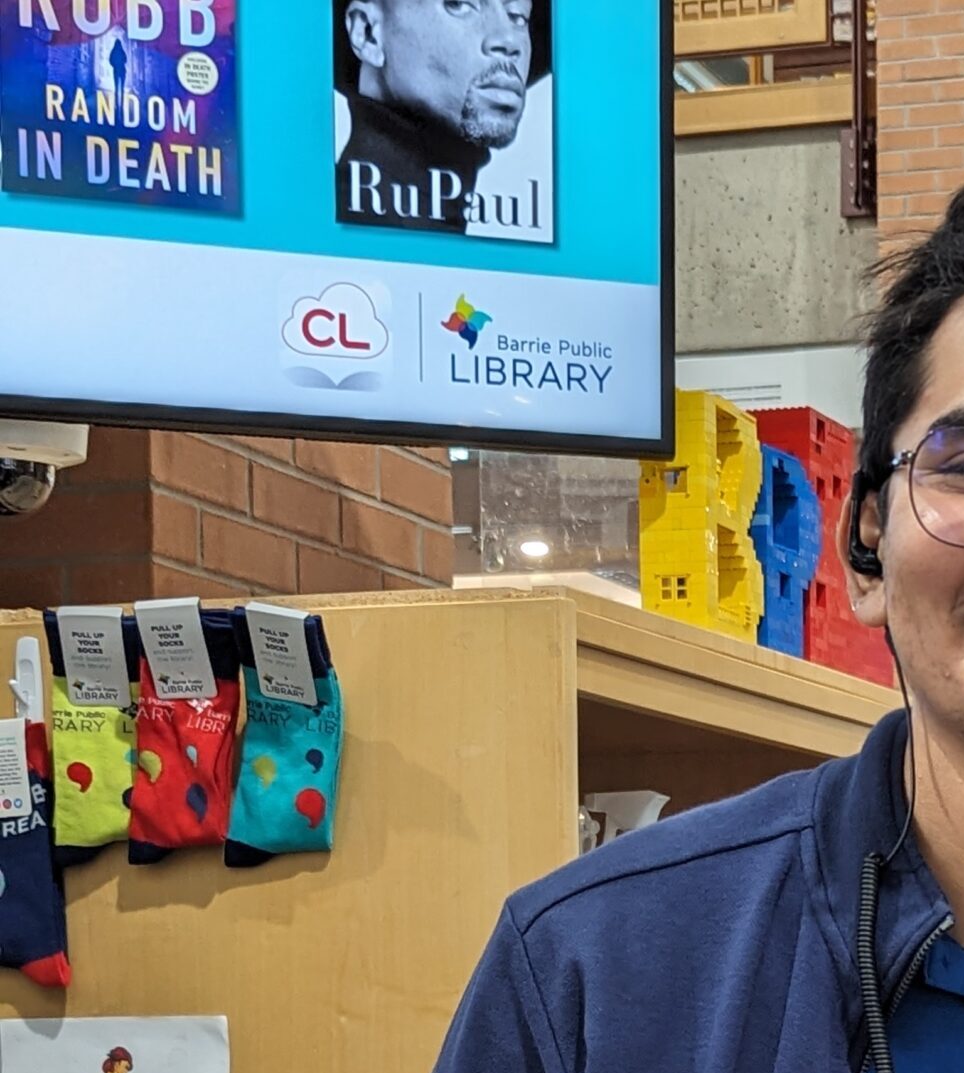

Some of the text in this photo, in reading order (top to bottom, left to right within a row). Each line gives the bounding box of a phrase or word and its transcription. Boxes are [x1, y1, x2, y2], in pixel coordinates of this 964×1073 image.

[45, 83, 197, 135] RANDOM
[17, 127, 223, 196] IN DEATH
[347, 159, 542, 230] RuPaul
[301, 307, 371, 351] CL
[497, 334, 613, 359] Barrie Public
[450, 352, 613, 394] LIBRARY
[71, 631, 92, 639] PULL
[150, 624, 170, 632] PULL
[259, 627, 278, 636] PULL
[264, 643, 289, 653] SOCKS
[265, 636, 285, 645] YOUR
[75, 691, 119, 700] LIBRARY
[161, 684, 204, 694] LIBRARY
[265, 684, 305, 699] LIBRARY
[76, 711, 106, 719] Public
[248, 709, 293, 727] RARY
[53, 718, 106, 733] RARY
[186, 713, 225, 735] LIBR
[1, 810, 46, 838] REA
